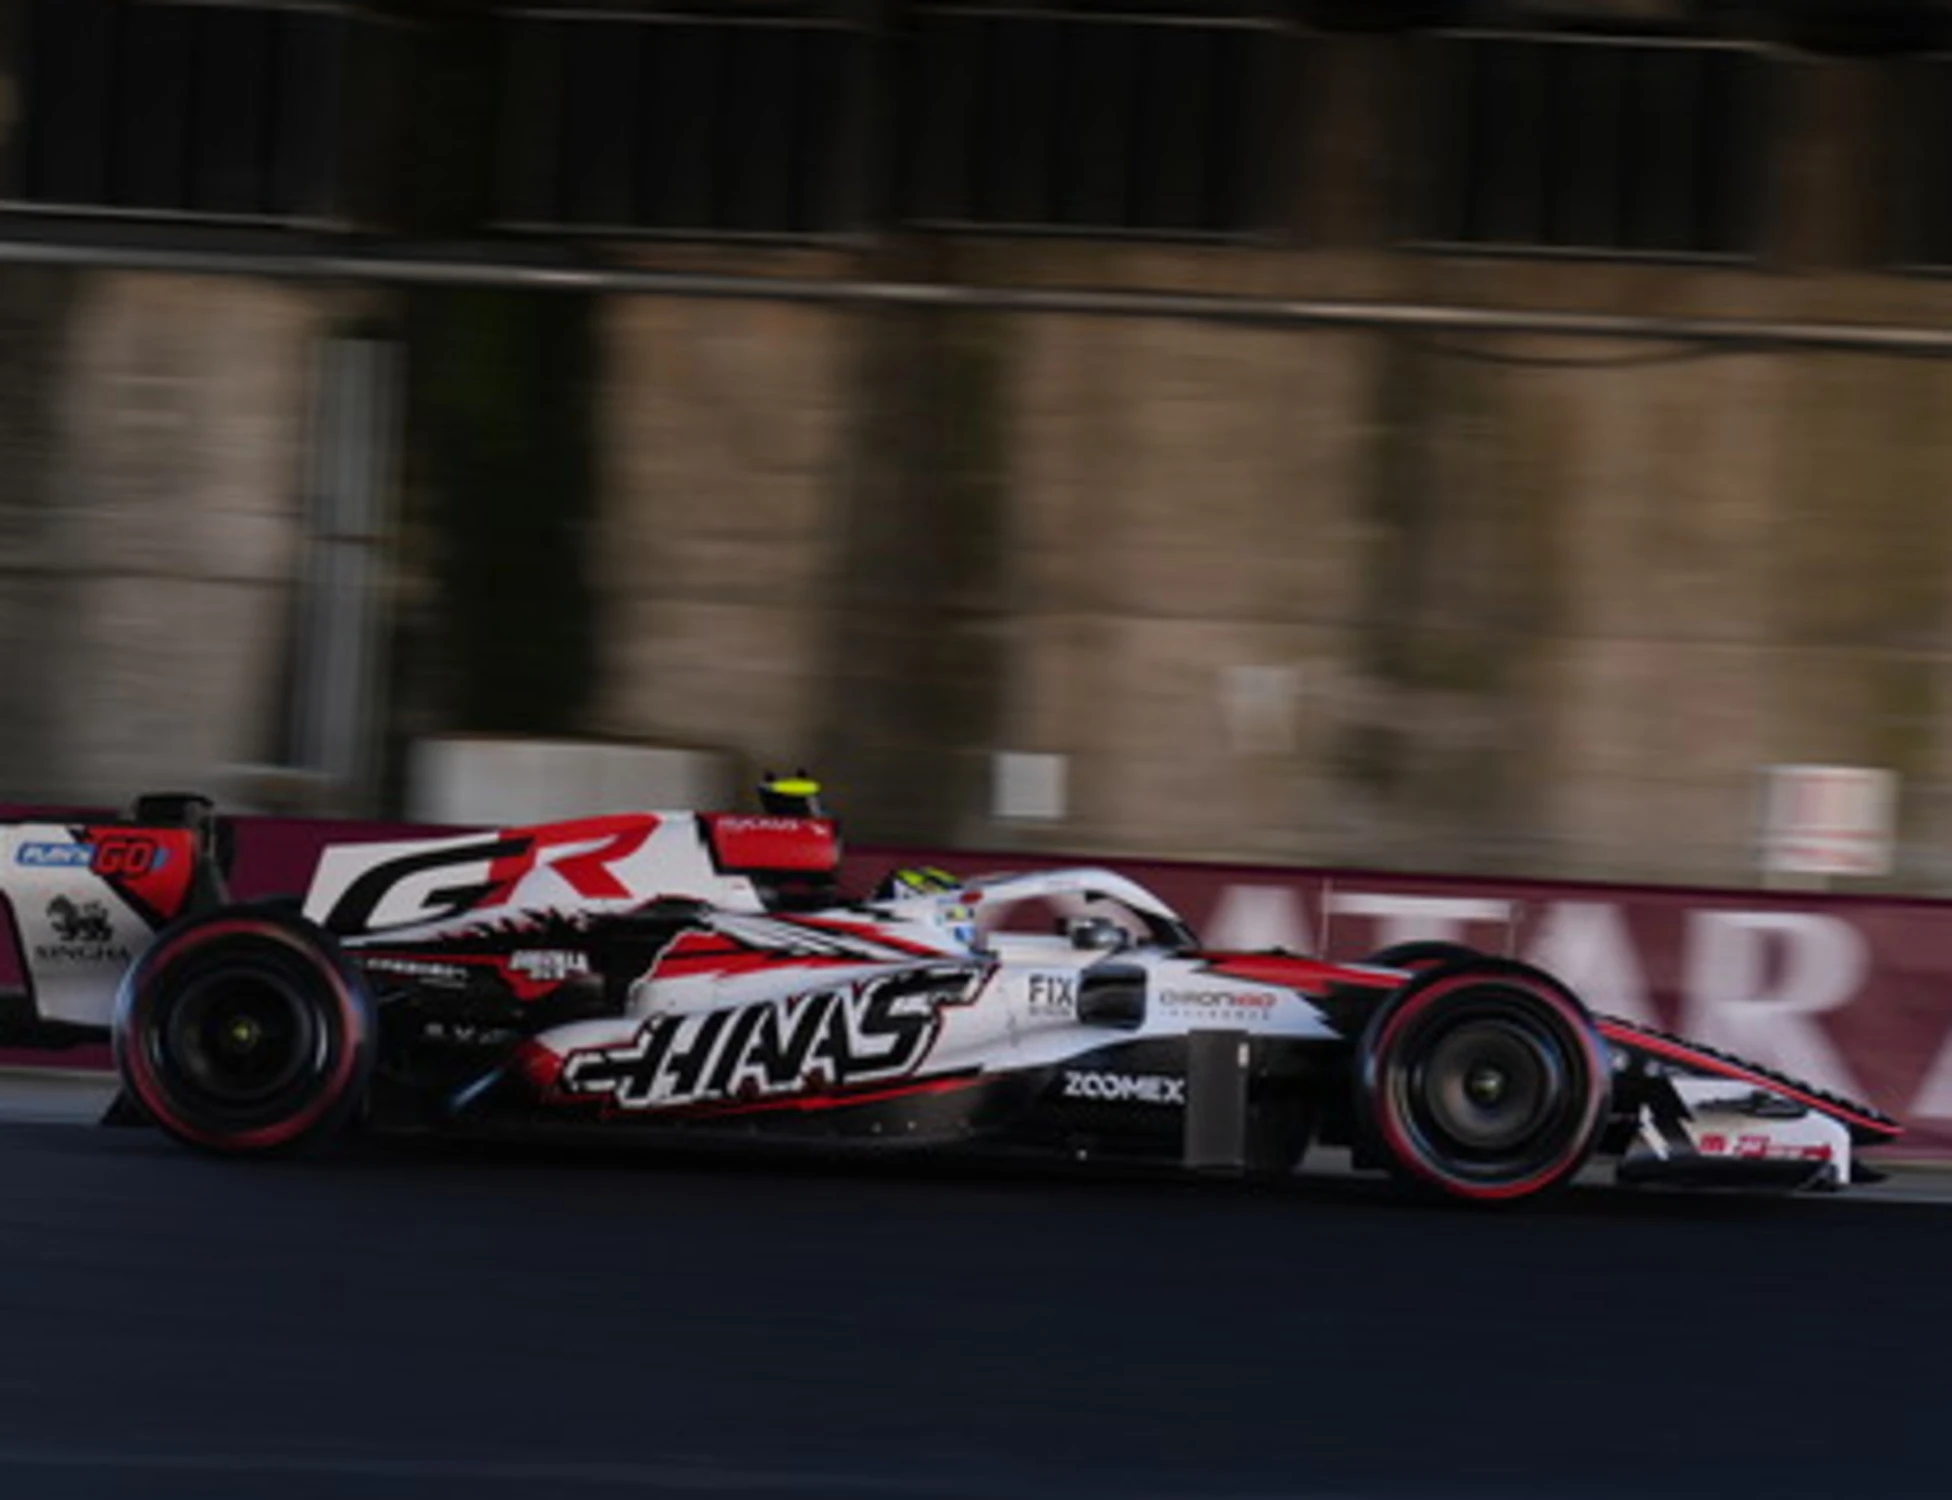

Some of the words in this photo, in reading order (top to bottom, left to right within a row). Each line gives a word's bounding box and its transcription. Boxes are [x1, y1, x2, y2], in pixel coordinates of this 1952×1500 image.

[95, 839, 153, 876] GO
[325, 812, 663, 931] GR
[1028, 974, 1073, 1005] FIX
[566, 965, 996, 1107] HAAS
[1063, 1071, 1185, 1101] ZOOMEX
